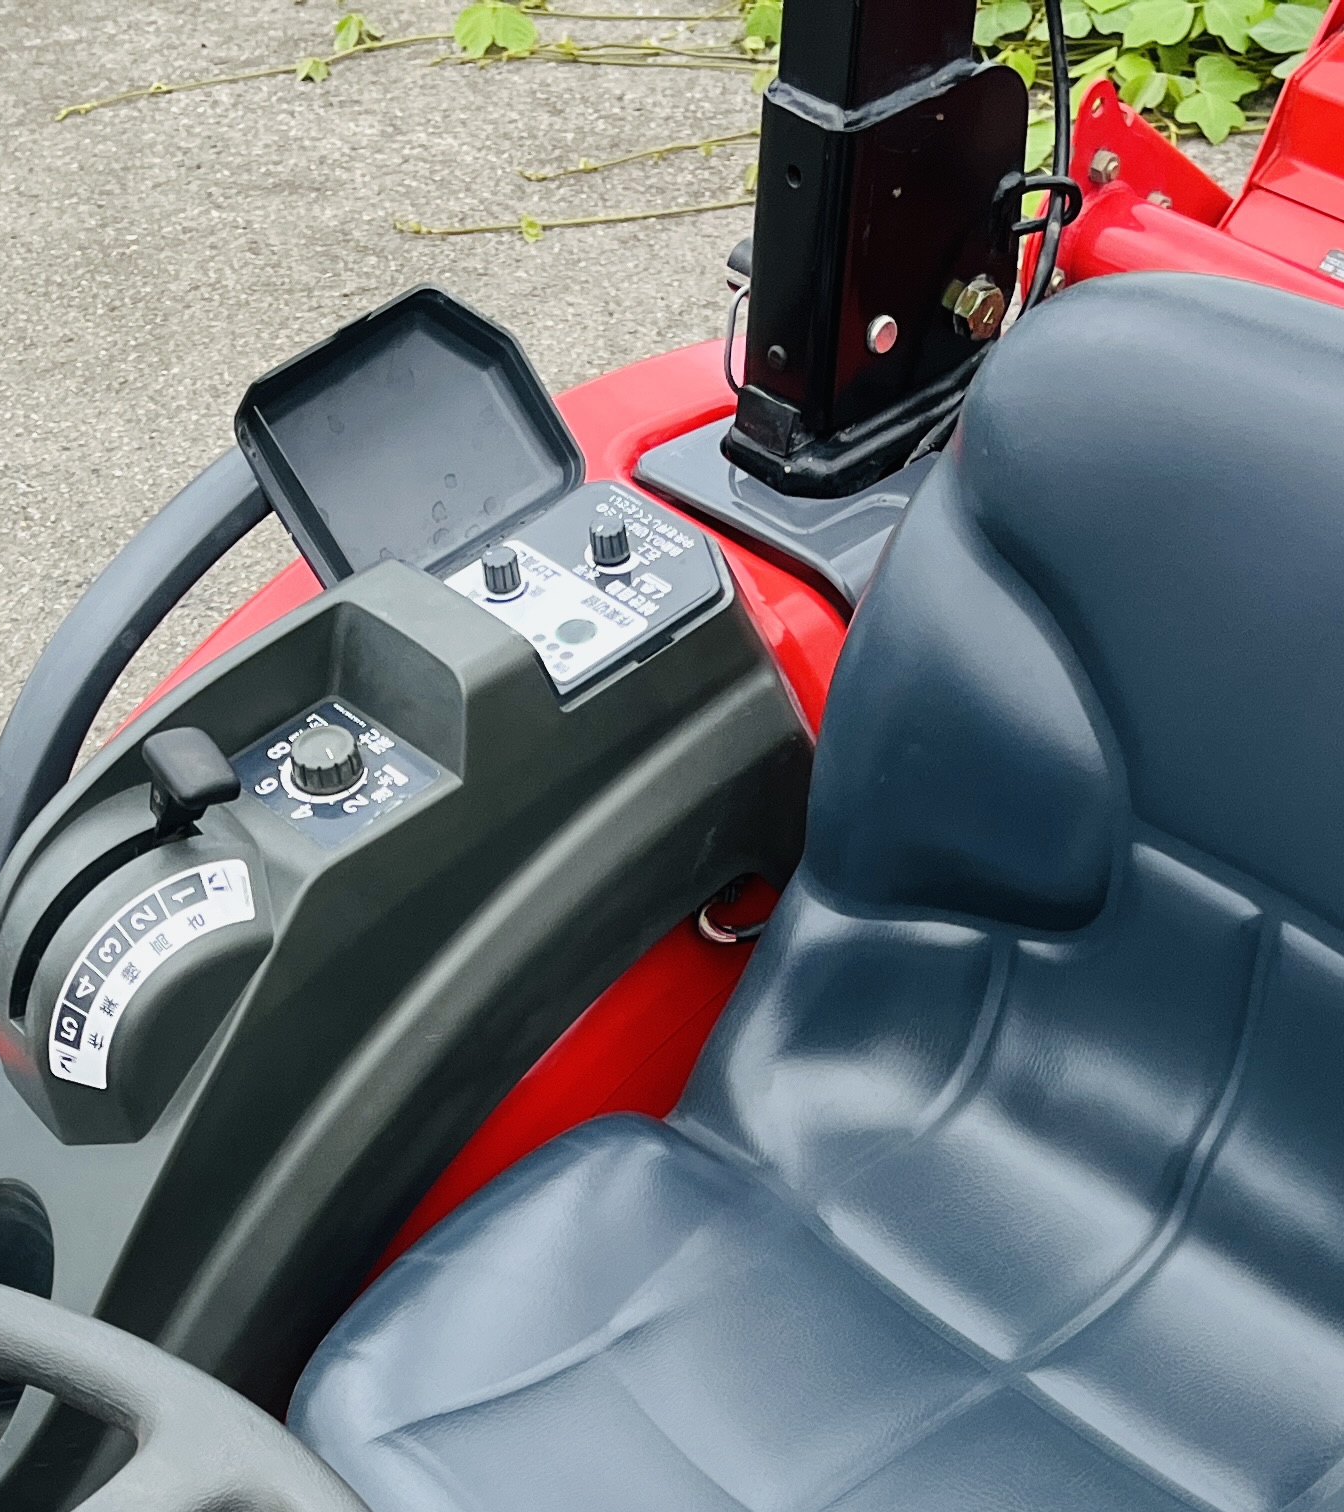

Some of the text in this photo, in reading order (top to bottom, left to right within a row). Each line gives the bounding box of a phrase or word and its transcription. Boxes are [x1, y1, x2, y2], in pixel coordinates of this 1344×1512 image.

[266, 741, 291, 760] 8
[254, 776, 279, 796] 6
[290, 803, 315, 820] 4
[342, 794, 369, 814] 2
[170, 885, 197, 905] 1
[129, 904, 160, 933] 2
[97, 936, 123, 963] 3
[74, 974, 98, 1000] 4
[58, 1015, 81, 1043] 5
